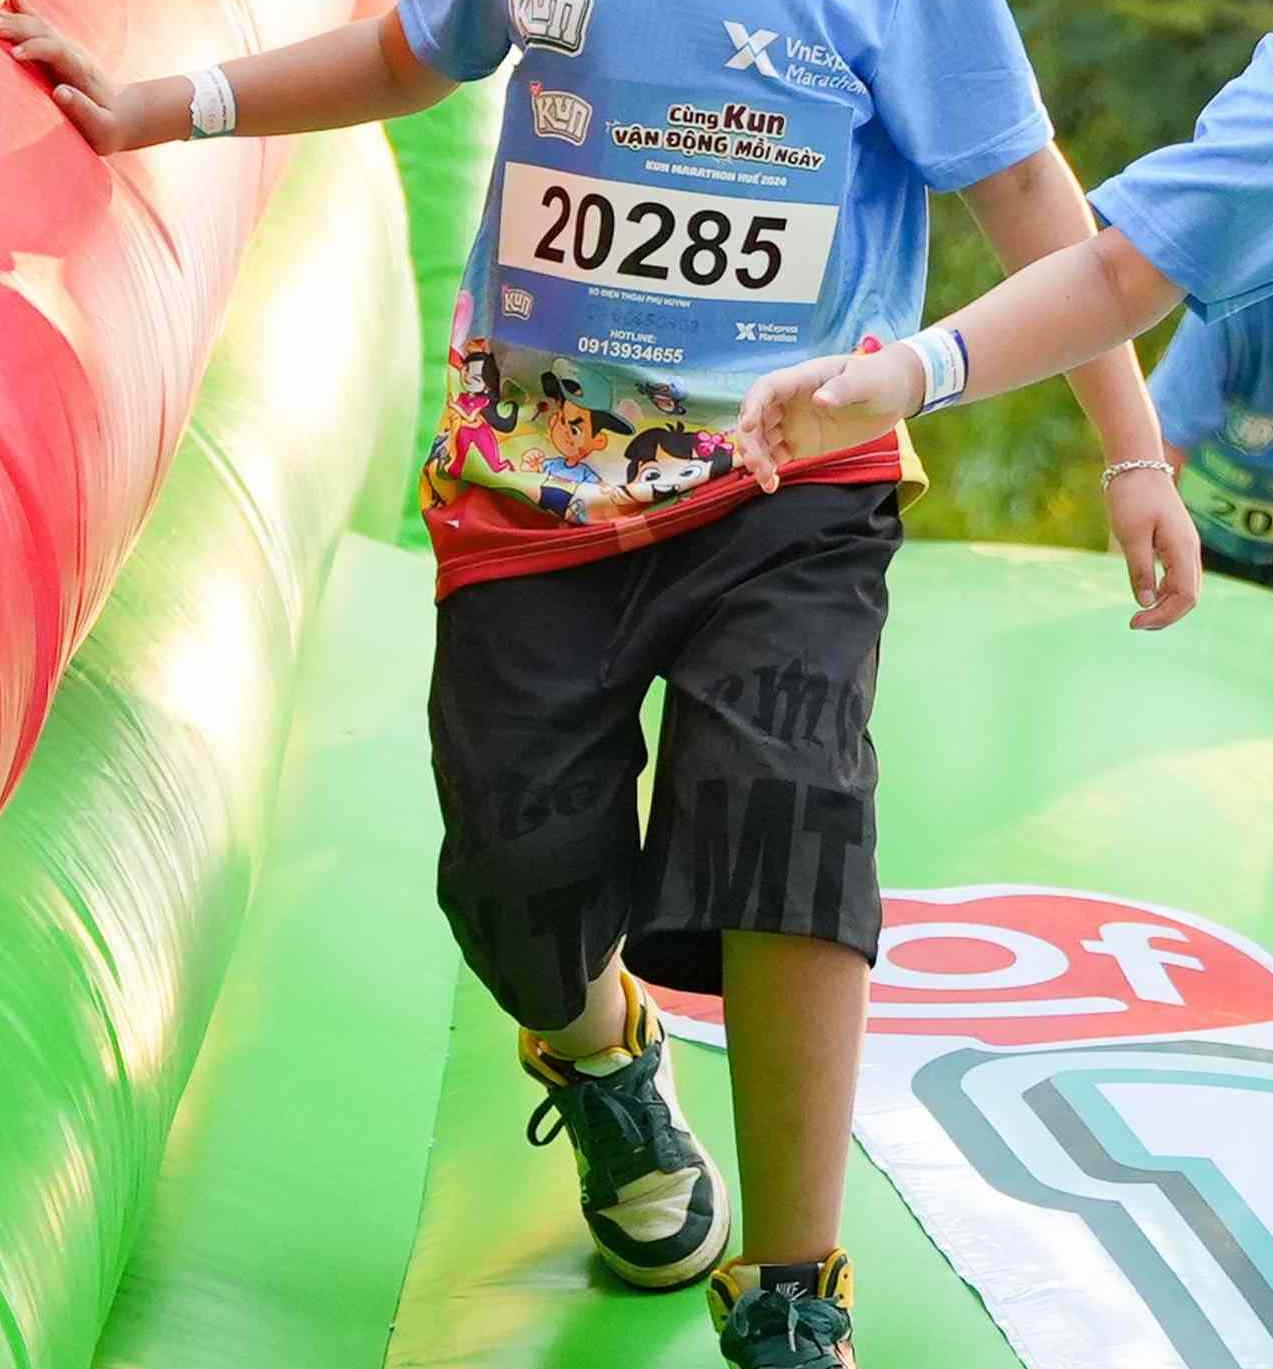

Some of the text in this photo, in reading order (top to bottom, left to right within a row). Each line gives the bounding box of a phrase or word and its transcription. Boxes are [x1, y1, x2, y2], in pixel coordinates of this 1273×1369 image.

[785, 37, 850, 73] VnExp
[670, 104, 785, 136] Cùng Kun
[613, 126, 660, 150] VẬN
[665, 129, 728, 155] ĐỘNG
[774, 146, 822, 169] NGÀY
[671, 164, 736, 182] MARATHON
[533, 185, 788, 290] 20285
[578, 336, 685, 364] 0913934655
